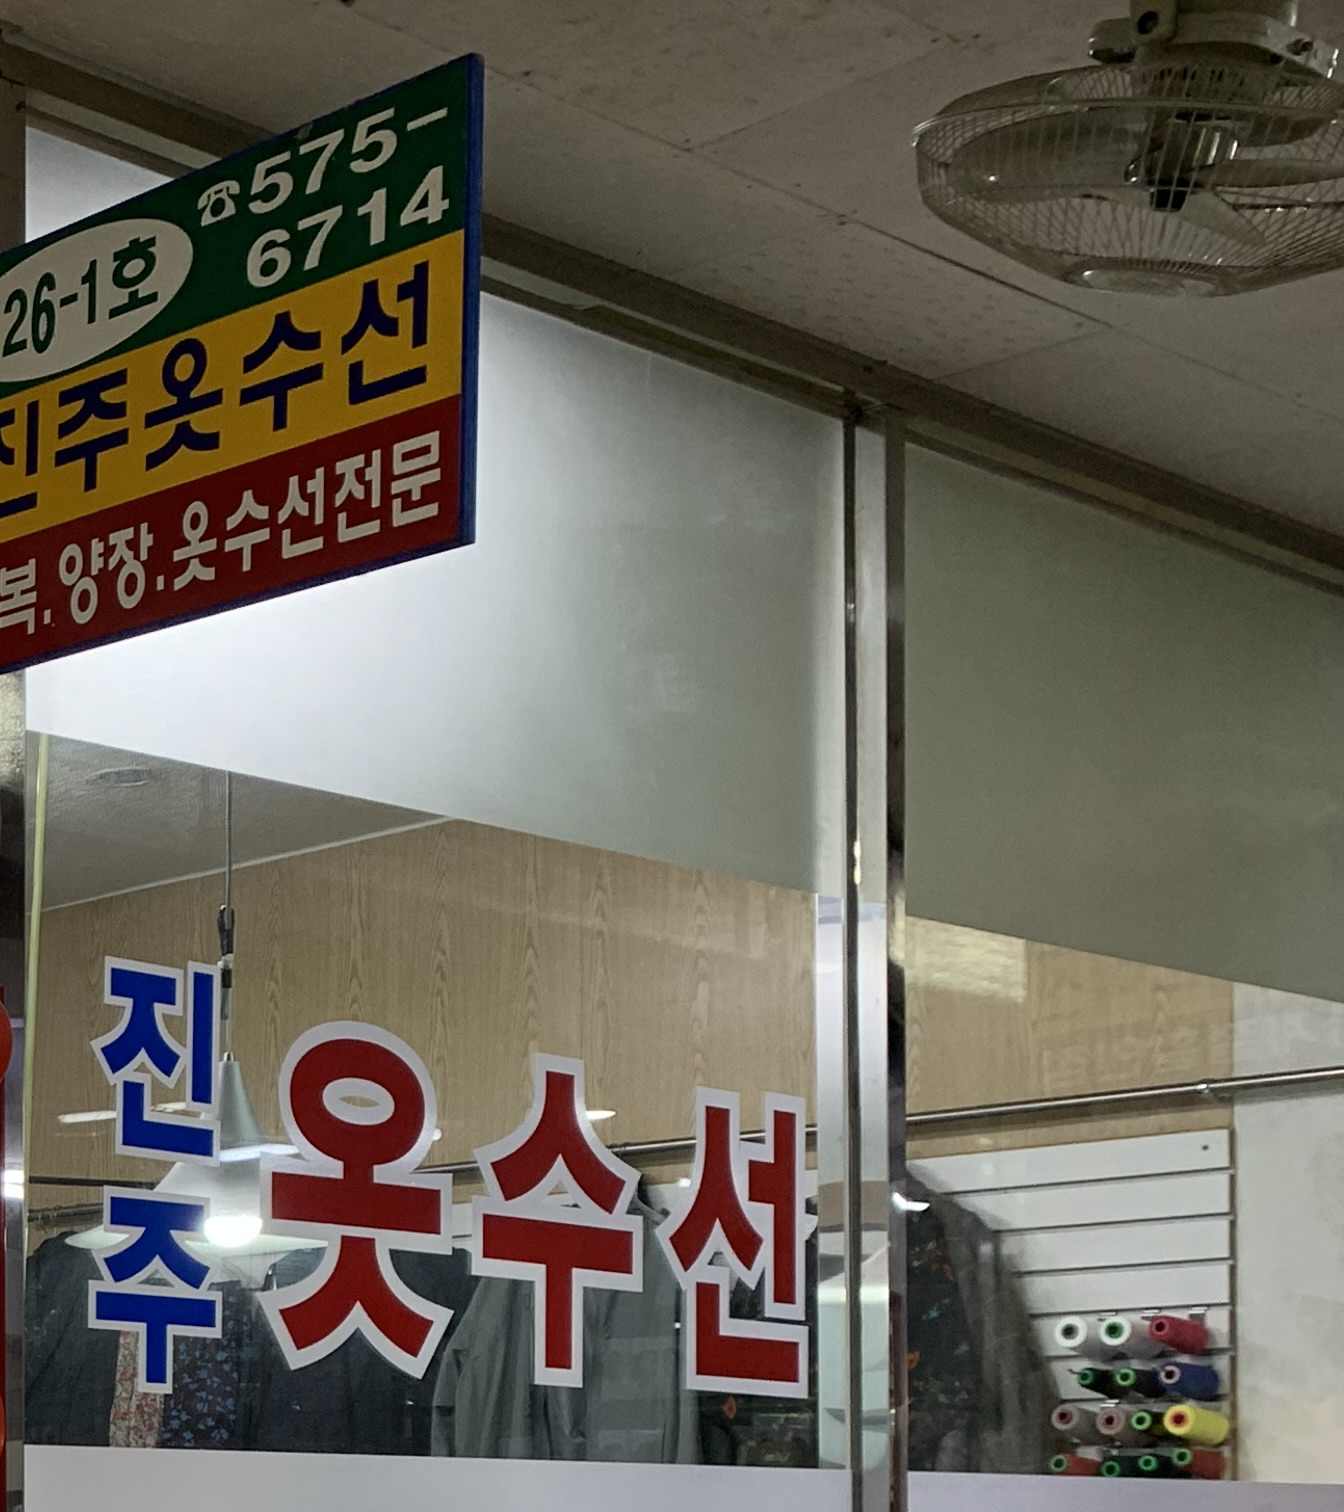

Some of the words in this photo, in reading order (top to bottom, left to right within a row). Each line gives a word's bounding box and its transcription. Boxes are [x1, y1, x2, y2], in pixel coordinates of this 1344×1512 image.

[246, 166, 450, 288] 6714
[248, 106, 449, 215] 575-
[95, 966, 216, 1386] 진주
[269, 1036, 802, 1386] 옷수선
